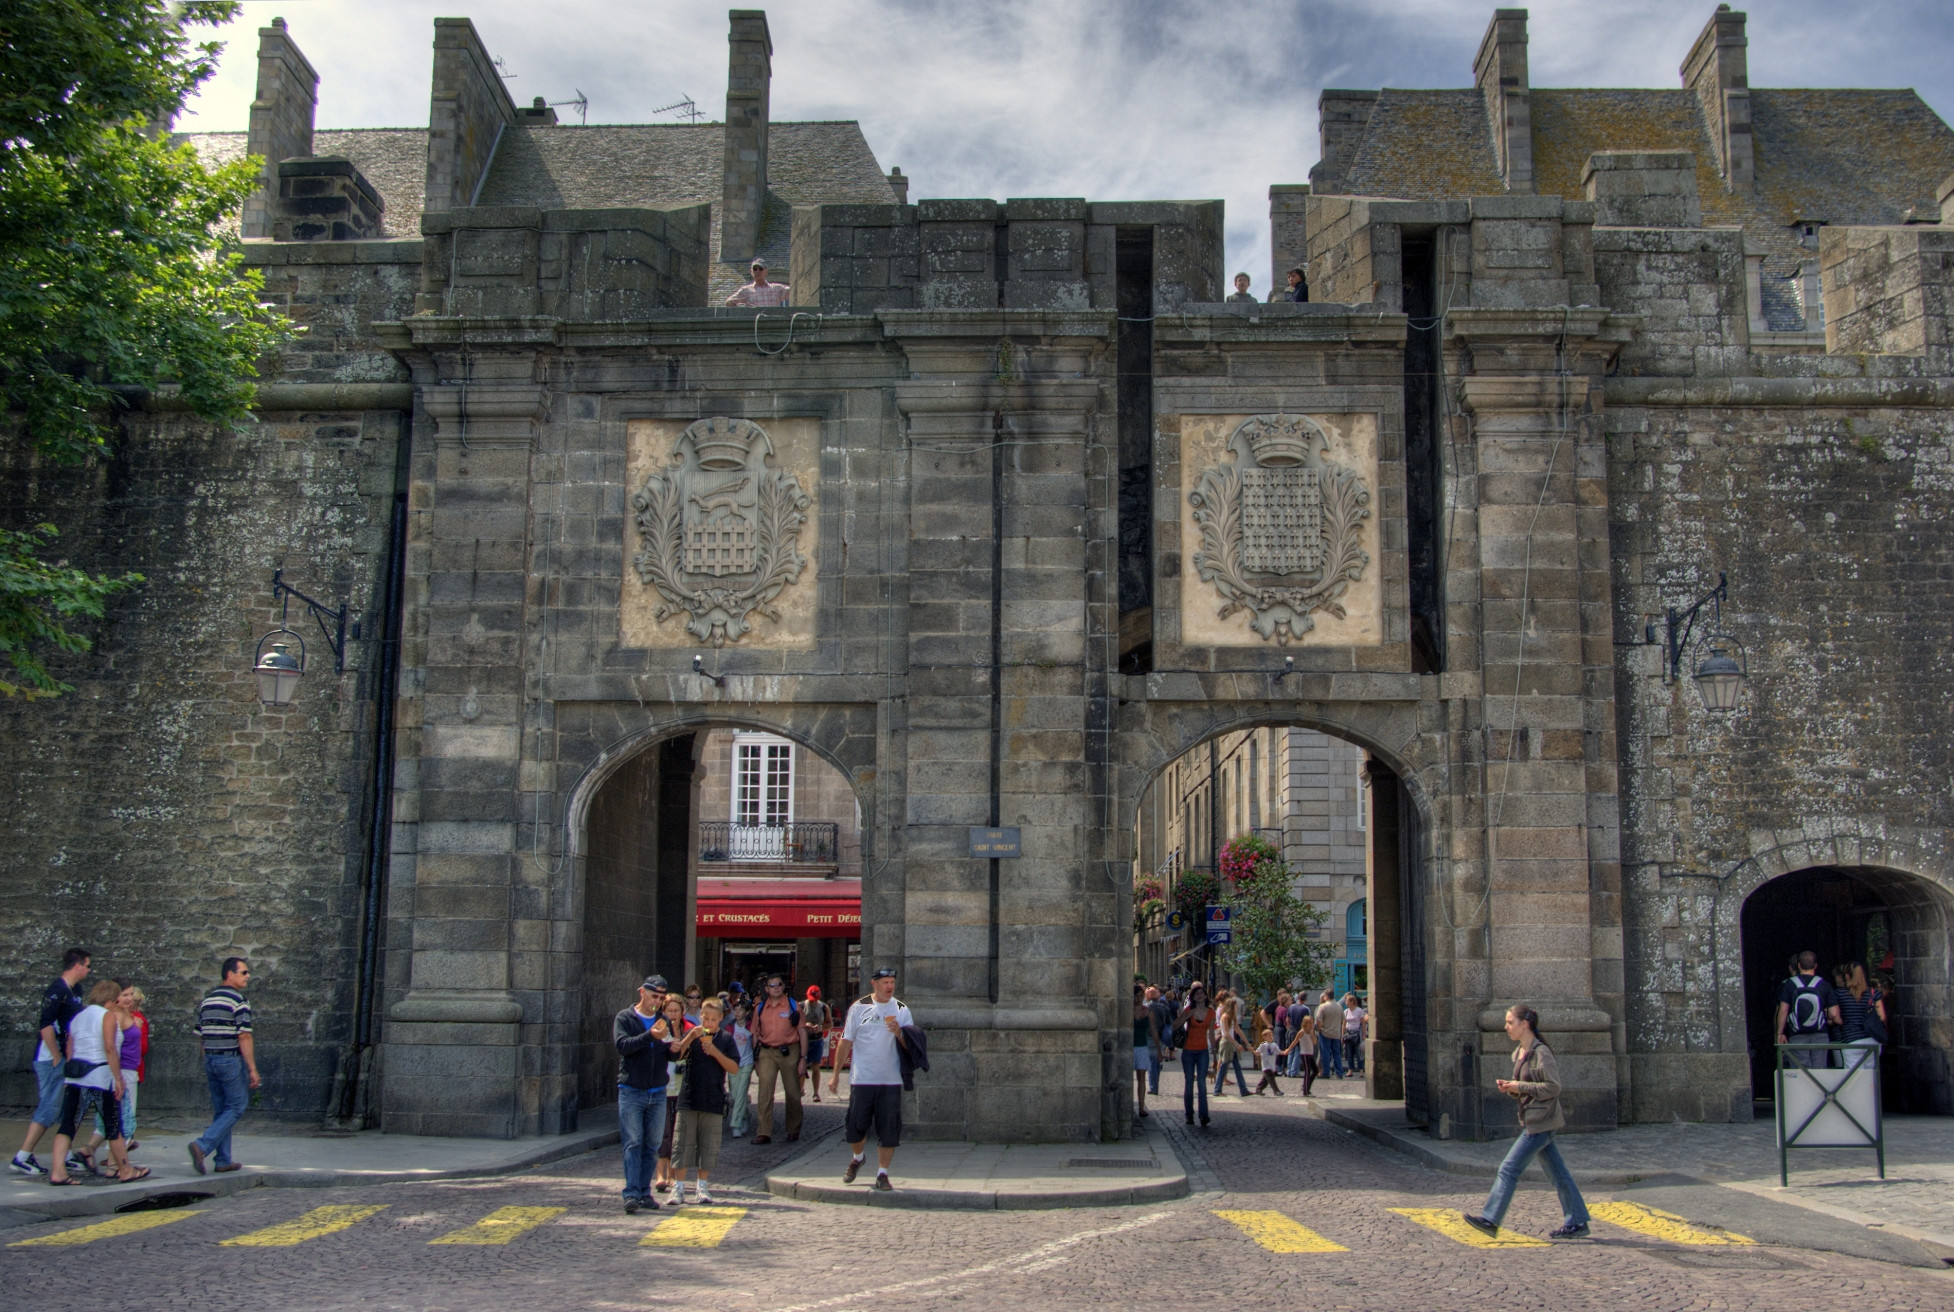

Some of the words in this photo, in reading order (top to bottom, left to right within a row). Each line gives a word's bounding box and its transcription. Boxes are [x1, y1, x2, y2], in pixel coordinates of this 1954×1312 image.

[703, 914, 715, 922] ET
[718, 913, 770, 923] CRUSTACÉS
[807, 914, 833, 923] PETIT
